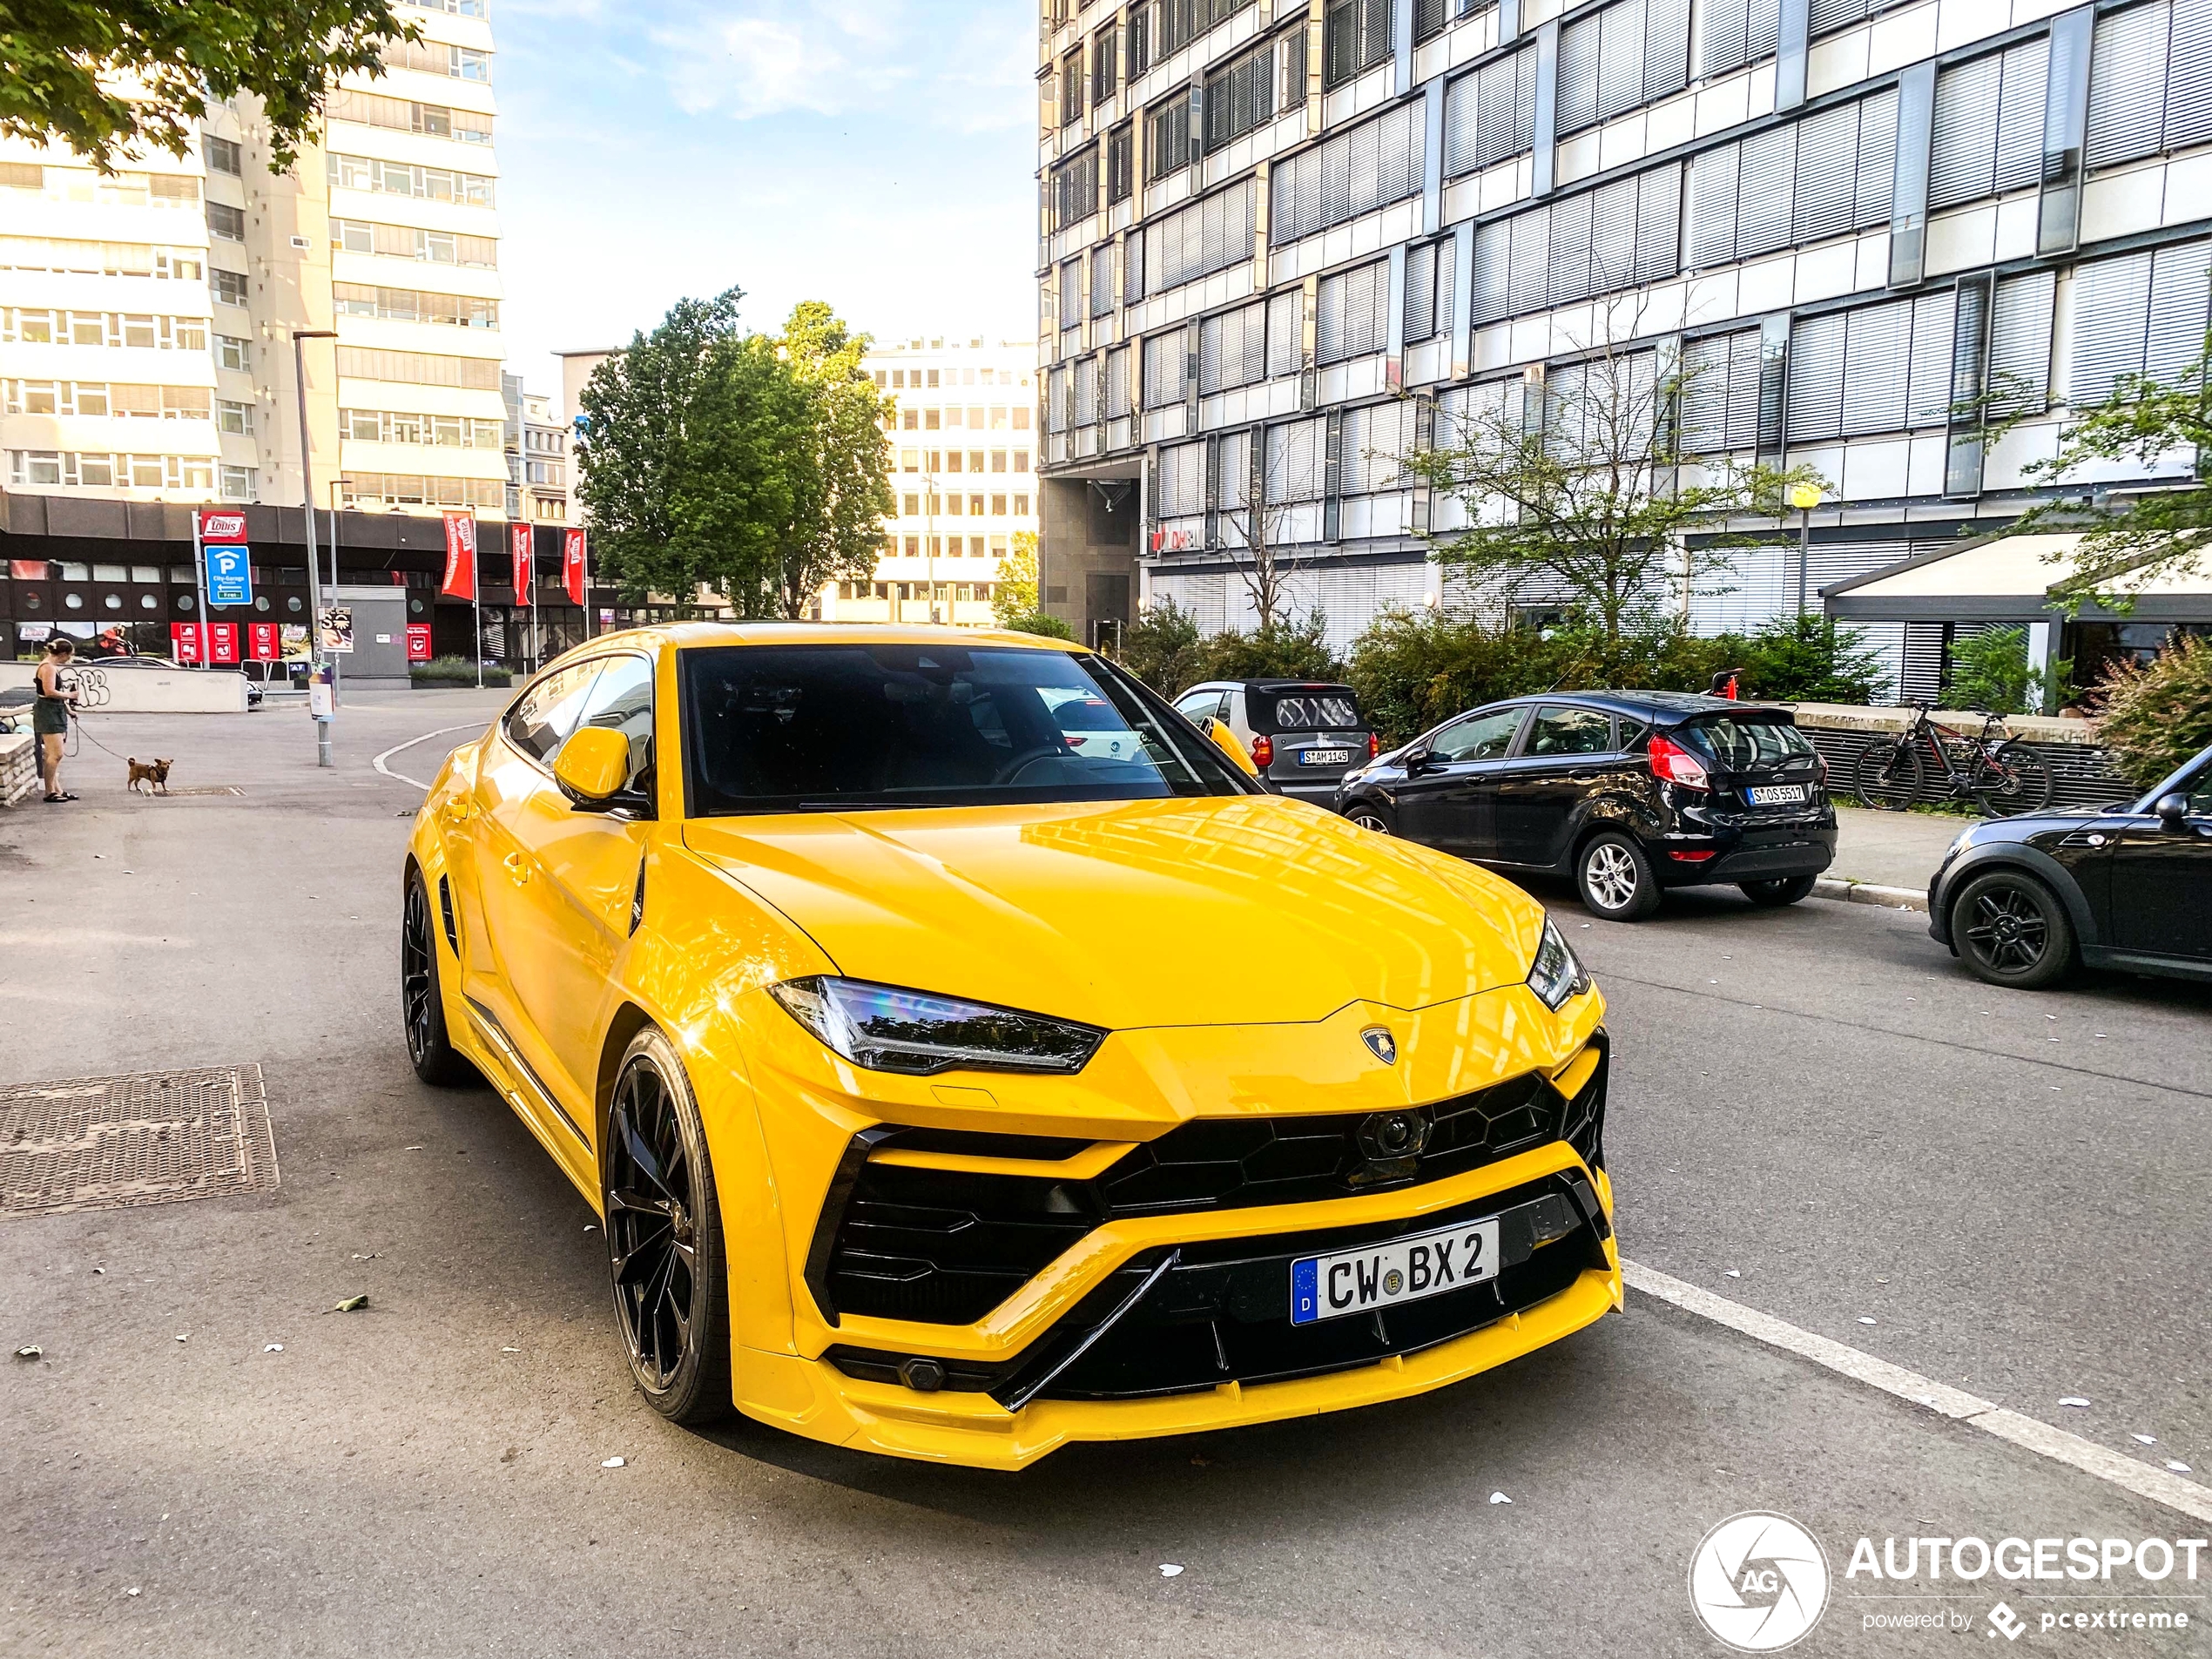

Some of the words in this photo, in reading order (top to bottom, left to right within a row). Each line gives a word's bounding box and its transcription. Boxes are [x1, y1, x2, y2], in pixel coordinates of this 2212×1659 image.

[212, 520, 237, 530] Louis
[219, 558, 236, 575] P
[1305, 752, 1312, 762] S
[1316, 751, 1327, 762] AM
[1328, 751, 1347, 762] 1145
[1754, 789, 1762, 801] S
[1766, 788, 1780, 800] OS
[1779, 787, 1801, 799] 5517
[1301, 1298, 1311, 1312] D
[1328, 1255, 1380, 1309] CW
[1409, 1238, 1454, 1292] BX
[1463, 1232, 1483, 1278] 2
